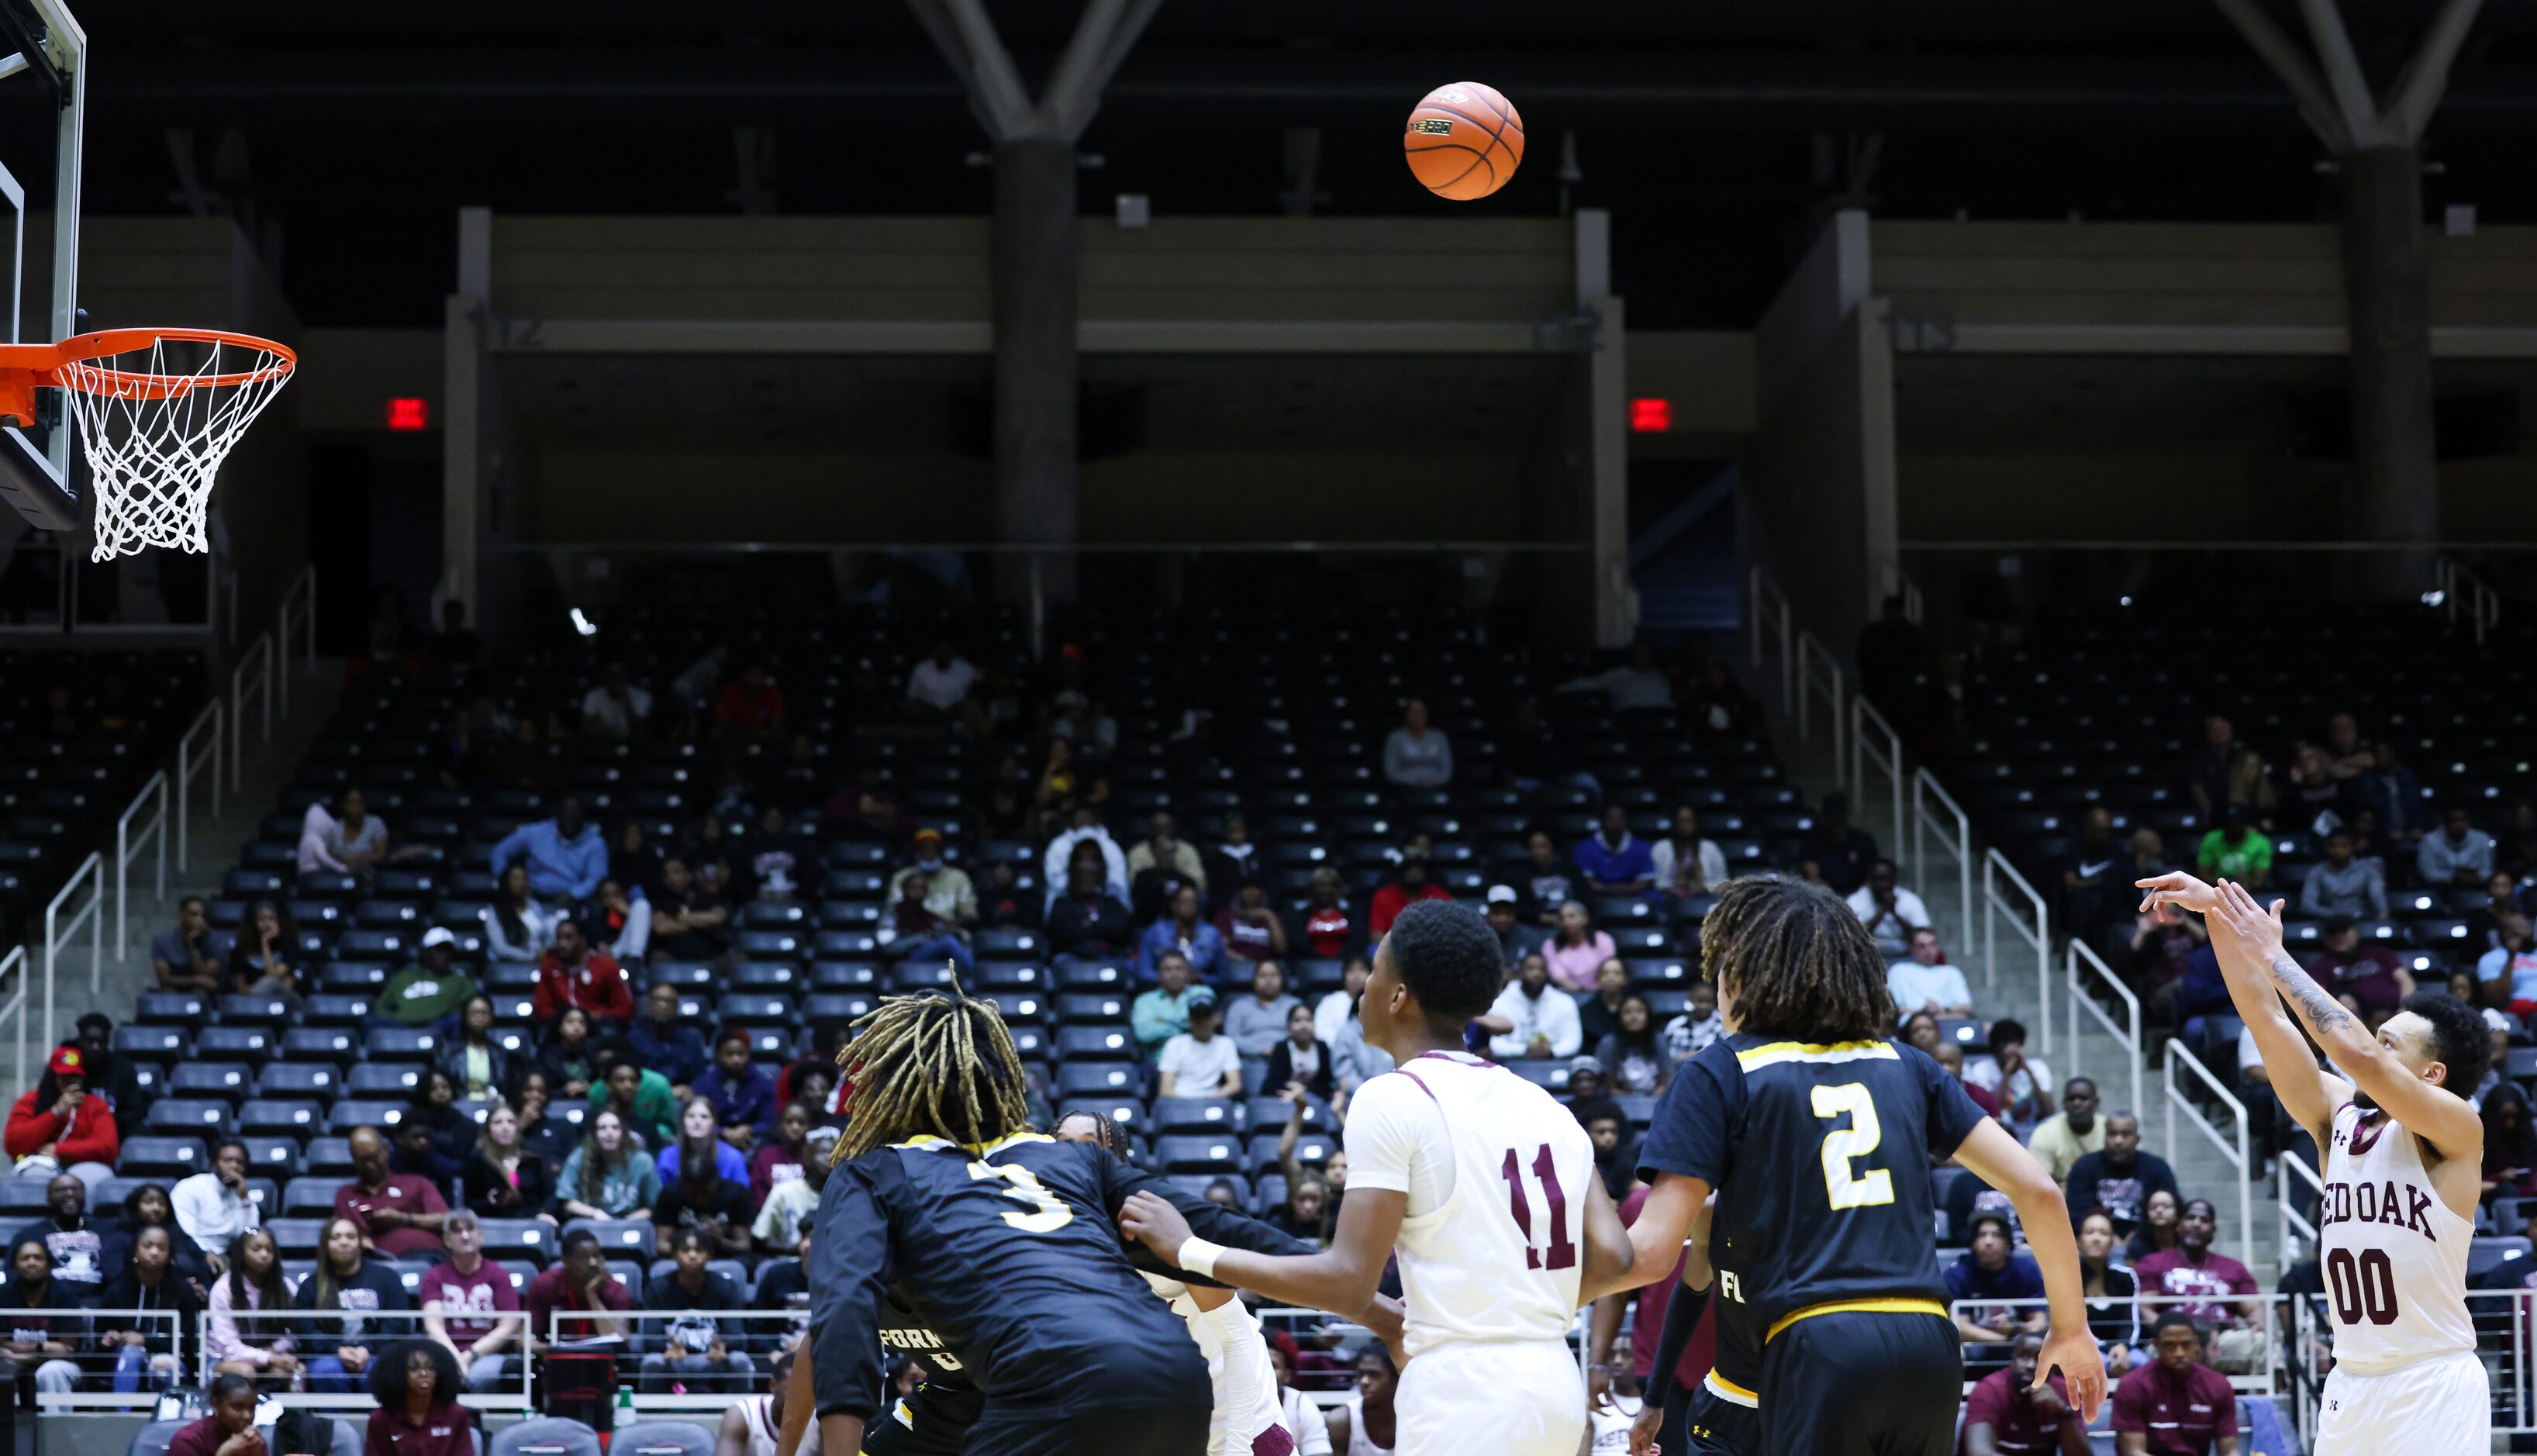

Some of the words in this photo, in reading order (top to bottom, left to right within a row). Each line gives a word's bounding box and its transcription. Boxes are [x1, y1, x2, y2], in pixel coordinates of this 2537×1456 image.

[1810, 1082, 1895, 1210] 2
[967, 1160, 1074, 1233] 3
[1502, 1144, 1576, 1271] 11
[2321, 1182, 2351, 1226] ED
[2356, 1181, 2437, 1243] OAK
[2327, 1247, 2399, 1326] 00
